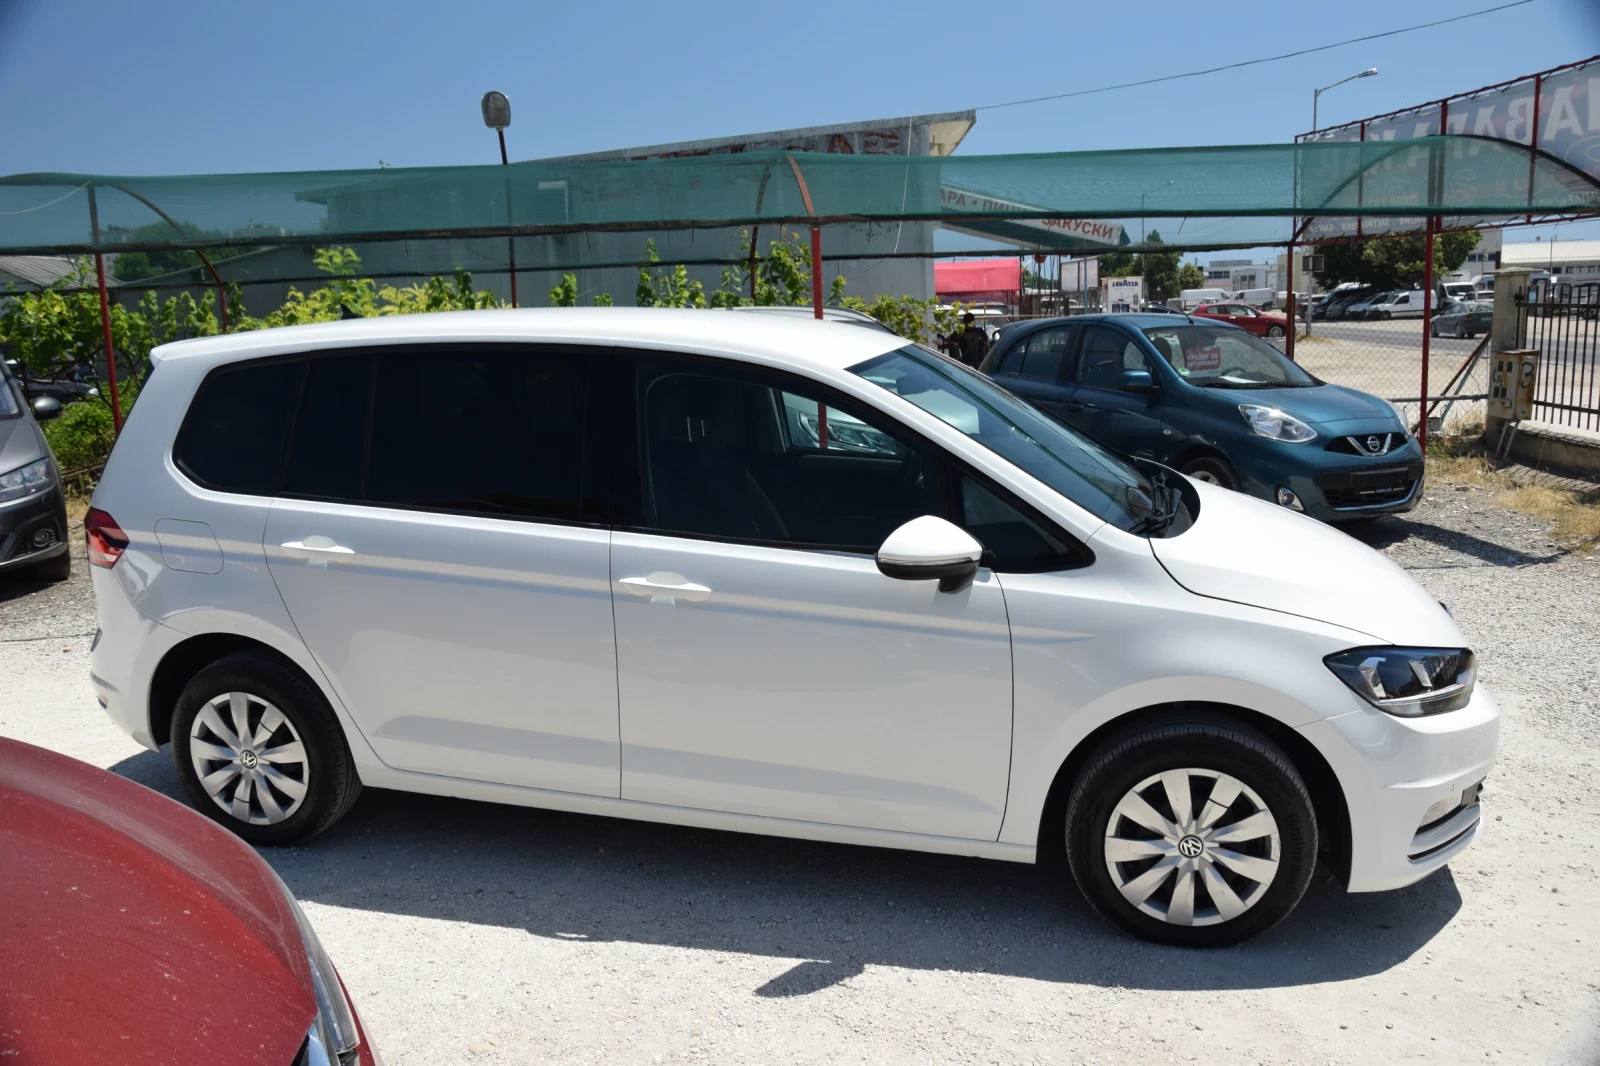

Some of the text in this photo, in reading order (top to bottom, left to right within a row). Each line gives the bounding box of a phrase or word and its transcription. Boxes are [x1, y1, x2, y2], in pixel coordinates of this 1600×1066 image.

[940, 189, 966, 207] АРА
[1042, 218, 1114, 240] ЗАКУСКИ
[1112, 279, 1139, 287] LAVAZZA
